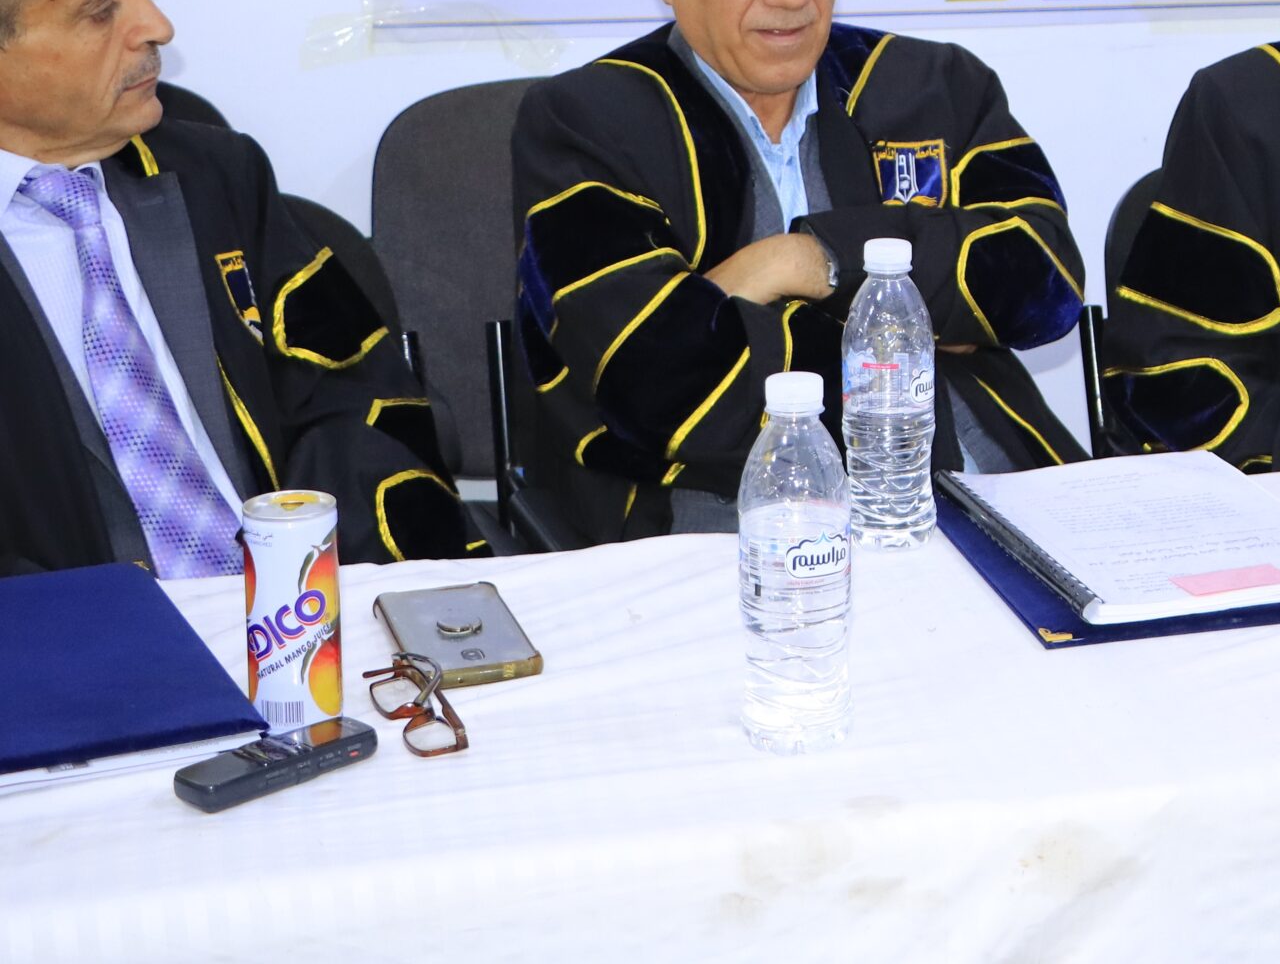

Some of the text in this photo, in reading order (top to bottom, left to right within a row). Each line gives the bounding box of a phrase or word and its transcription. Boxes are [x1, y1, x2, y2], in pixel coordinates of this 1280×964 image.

[257, 621, 331, 679] NATURAL MANGO JUICE
